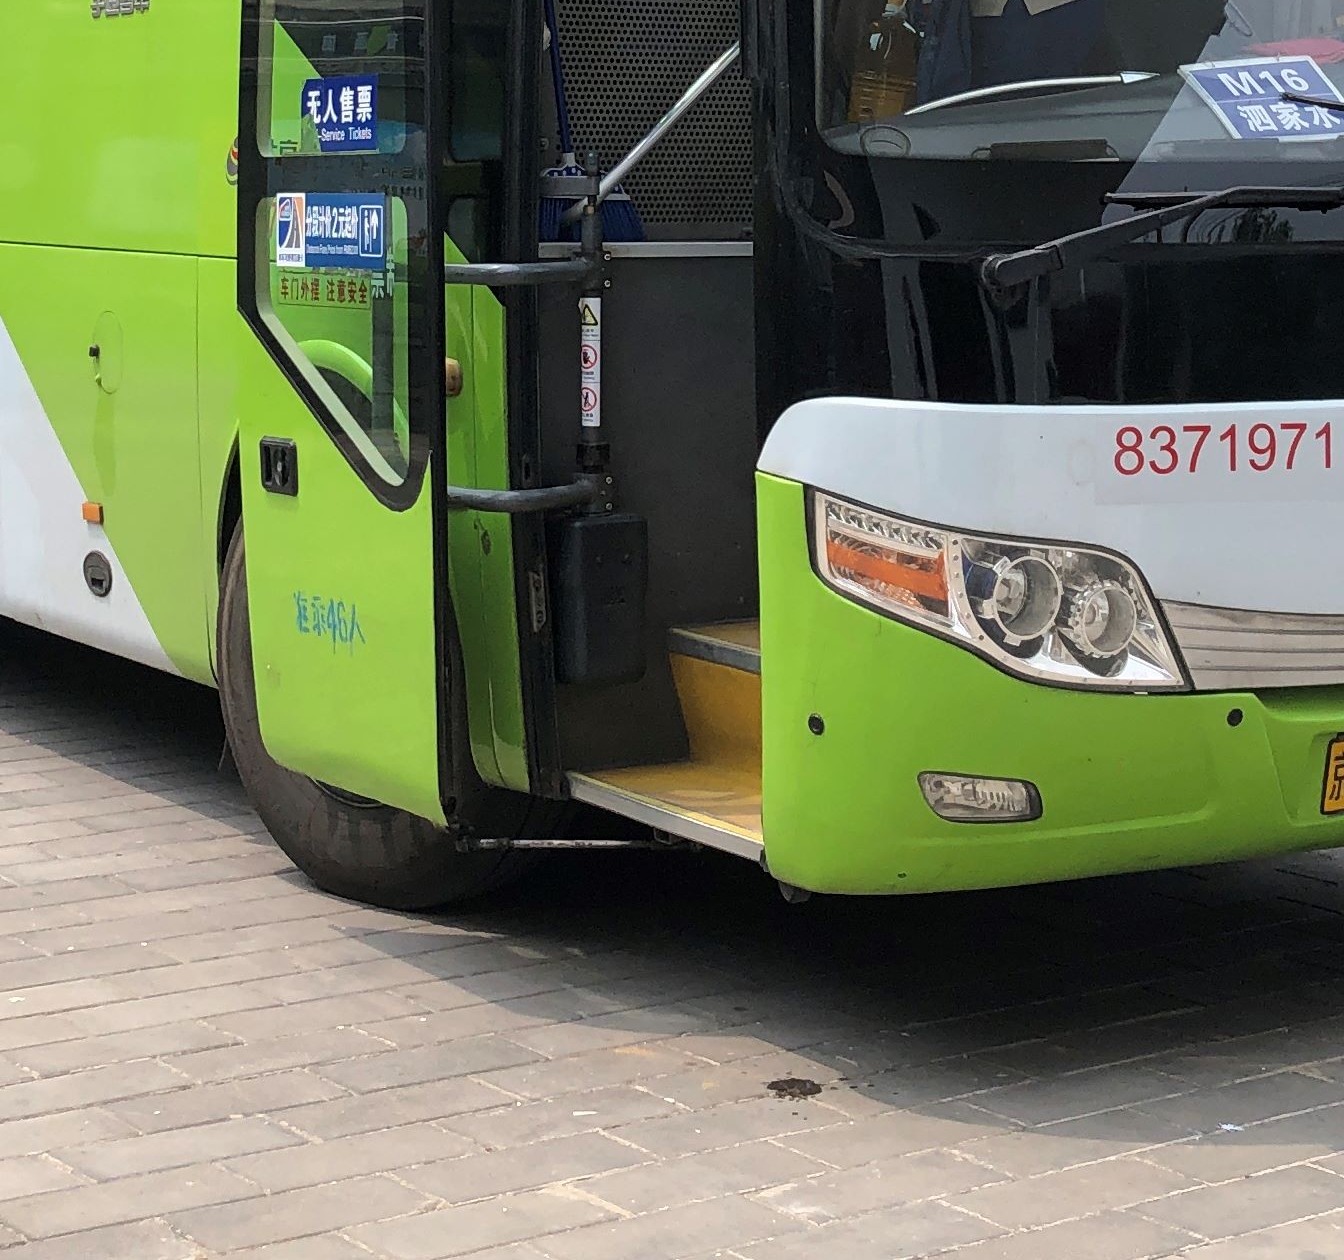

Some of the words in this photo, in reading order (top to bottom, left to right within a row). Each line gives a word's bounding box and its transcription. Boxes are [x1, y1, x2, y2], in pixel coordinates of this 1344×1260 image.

[1216, 68, 1310, 97] M16
[306, 85, 373, 124] 无人售票
[1236, 101, 1341, 132] 泗家水
[348, 126, 373, 140] Tickets
[325, 278, 369, 305] 注意安全
[1114, 421, 1332, 476] 8371971
